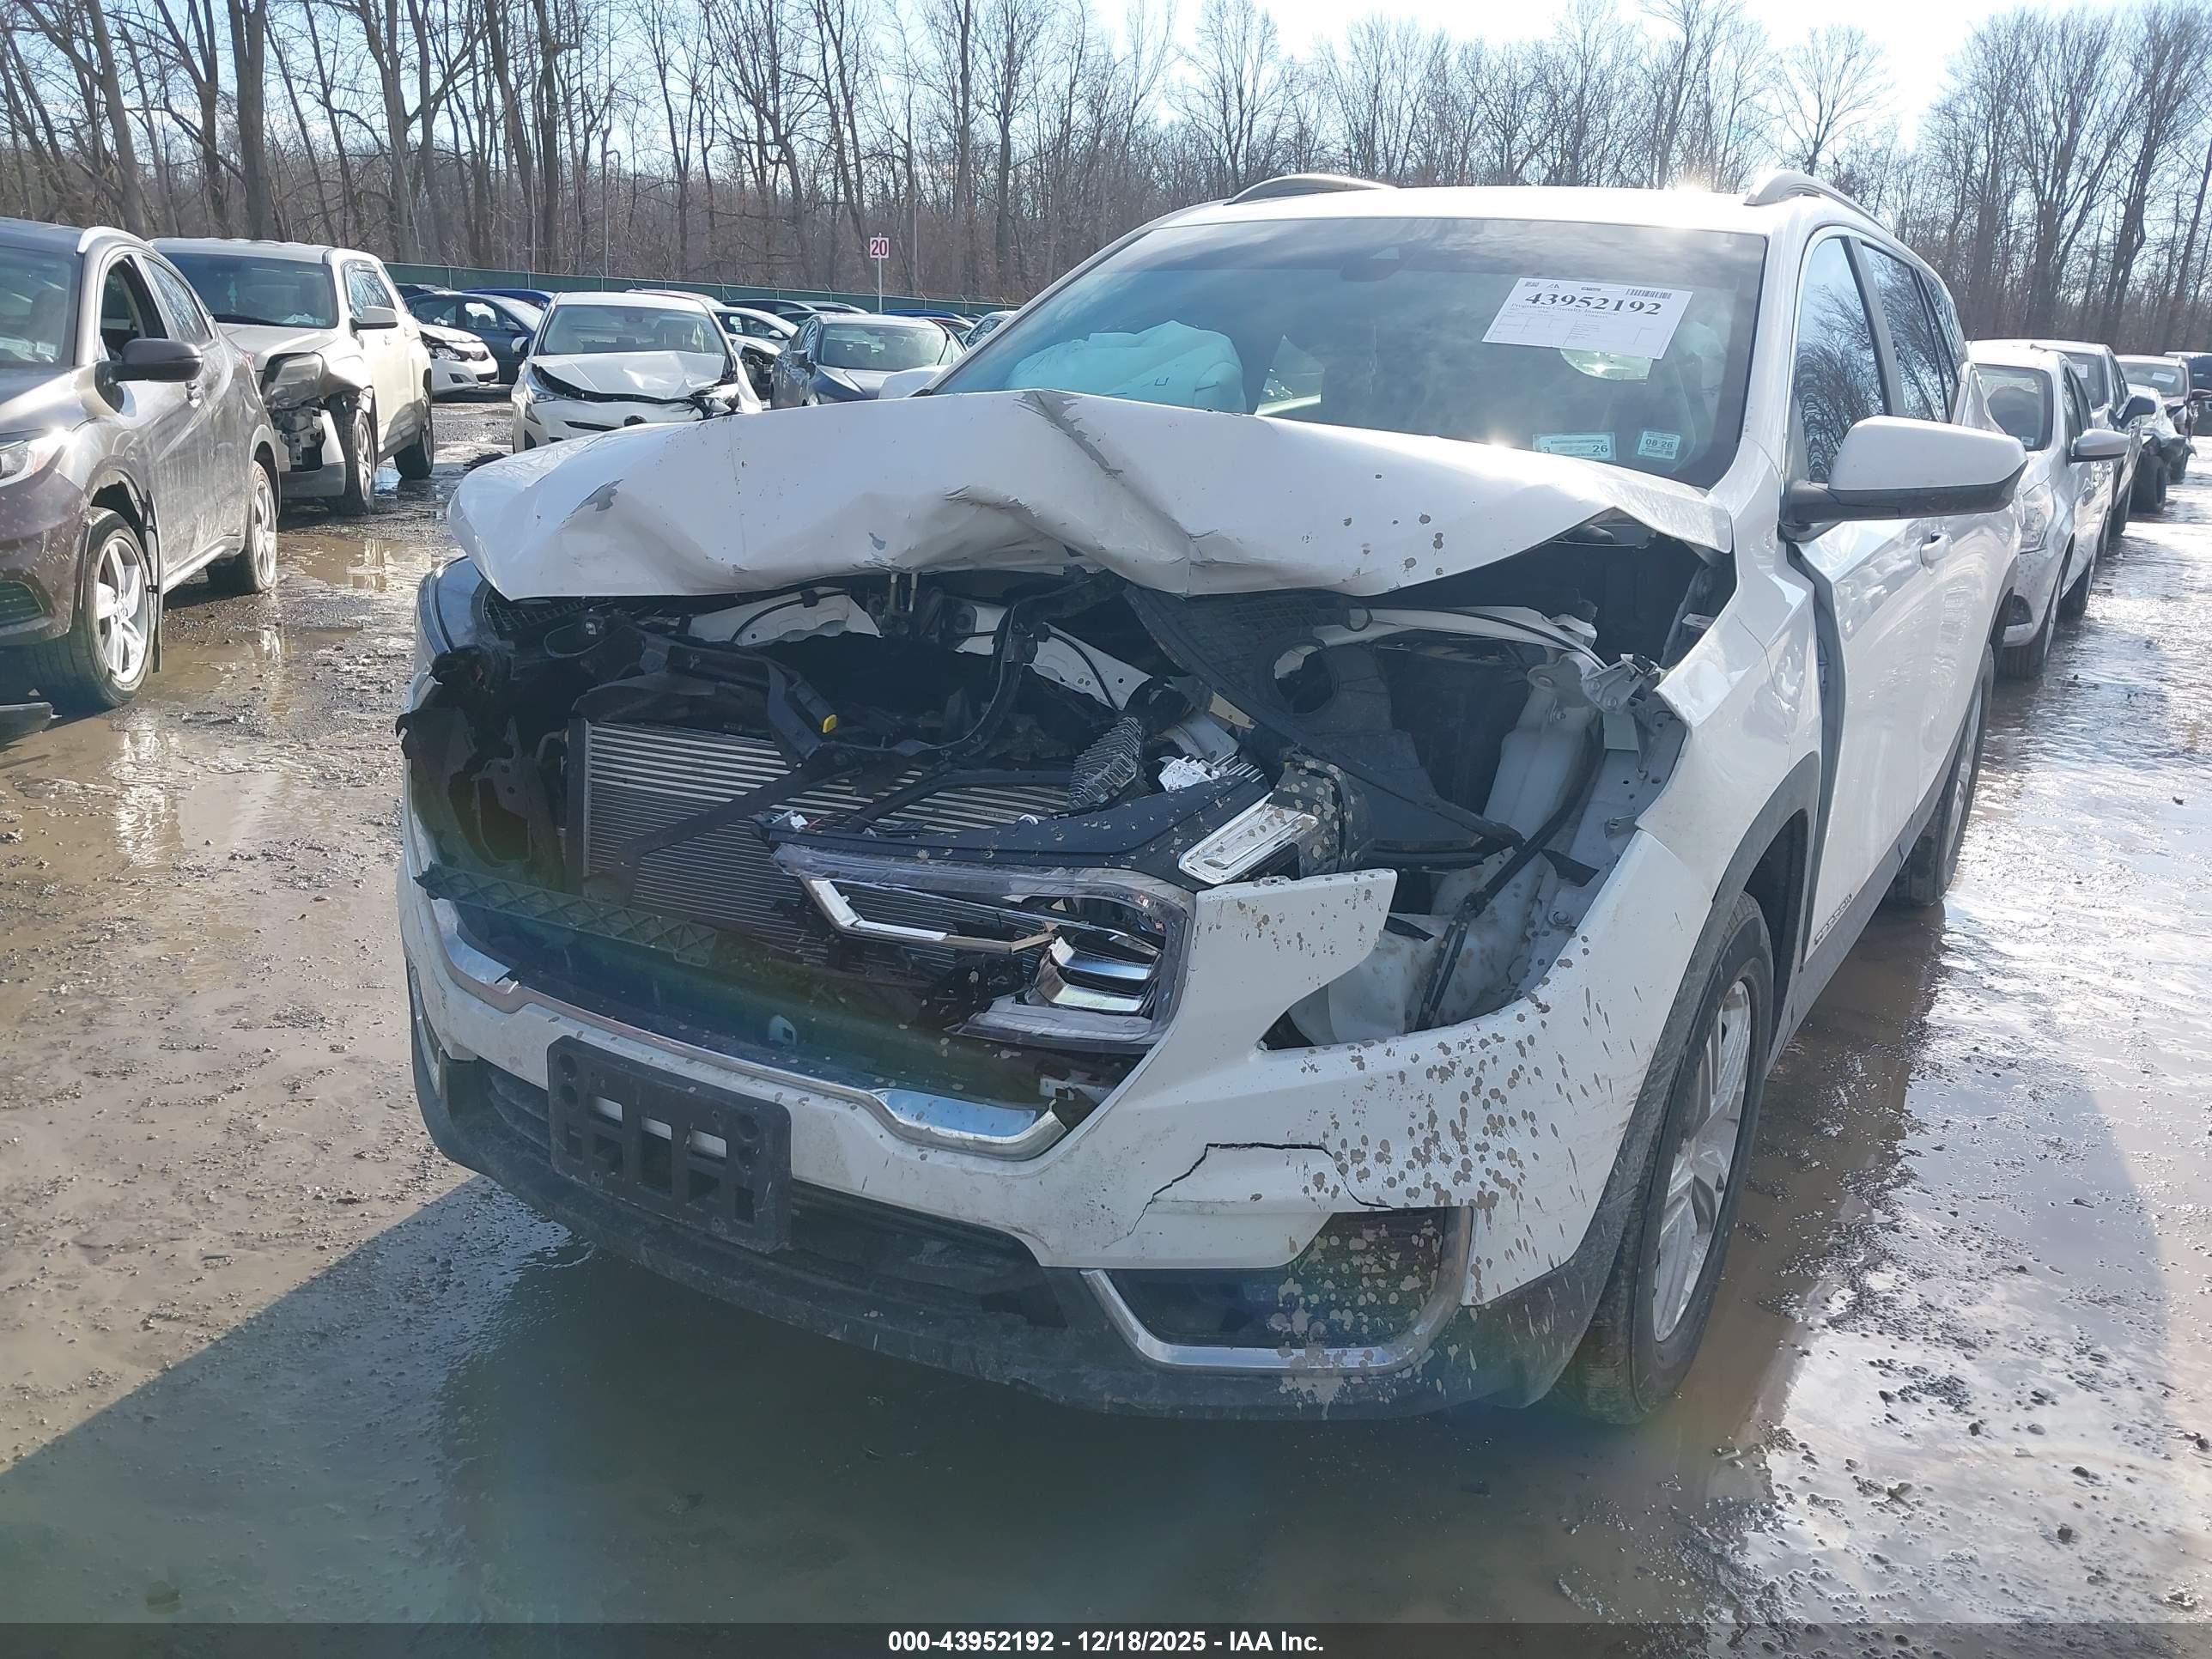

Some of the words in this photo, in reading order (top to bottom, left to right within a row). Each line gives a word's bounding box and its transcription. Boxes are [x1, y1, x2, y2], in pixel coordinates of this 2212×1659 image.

[872, 240, 888, 255] 20
[1524, 292, 1662, 316] 43952192
[1592, 445, 1608, 453] 26
